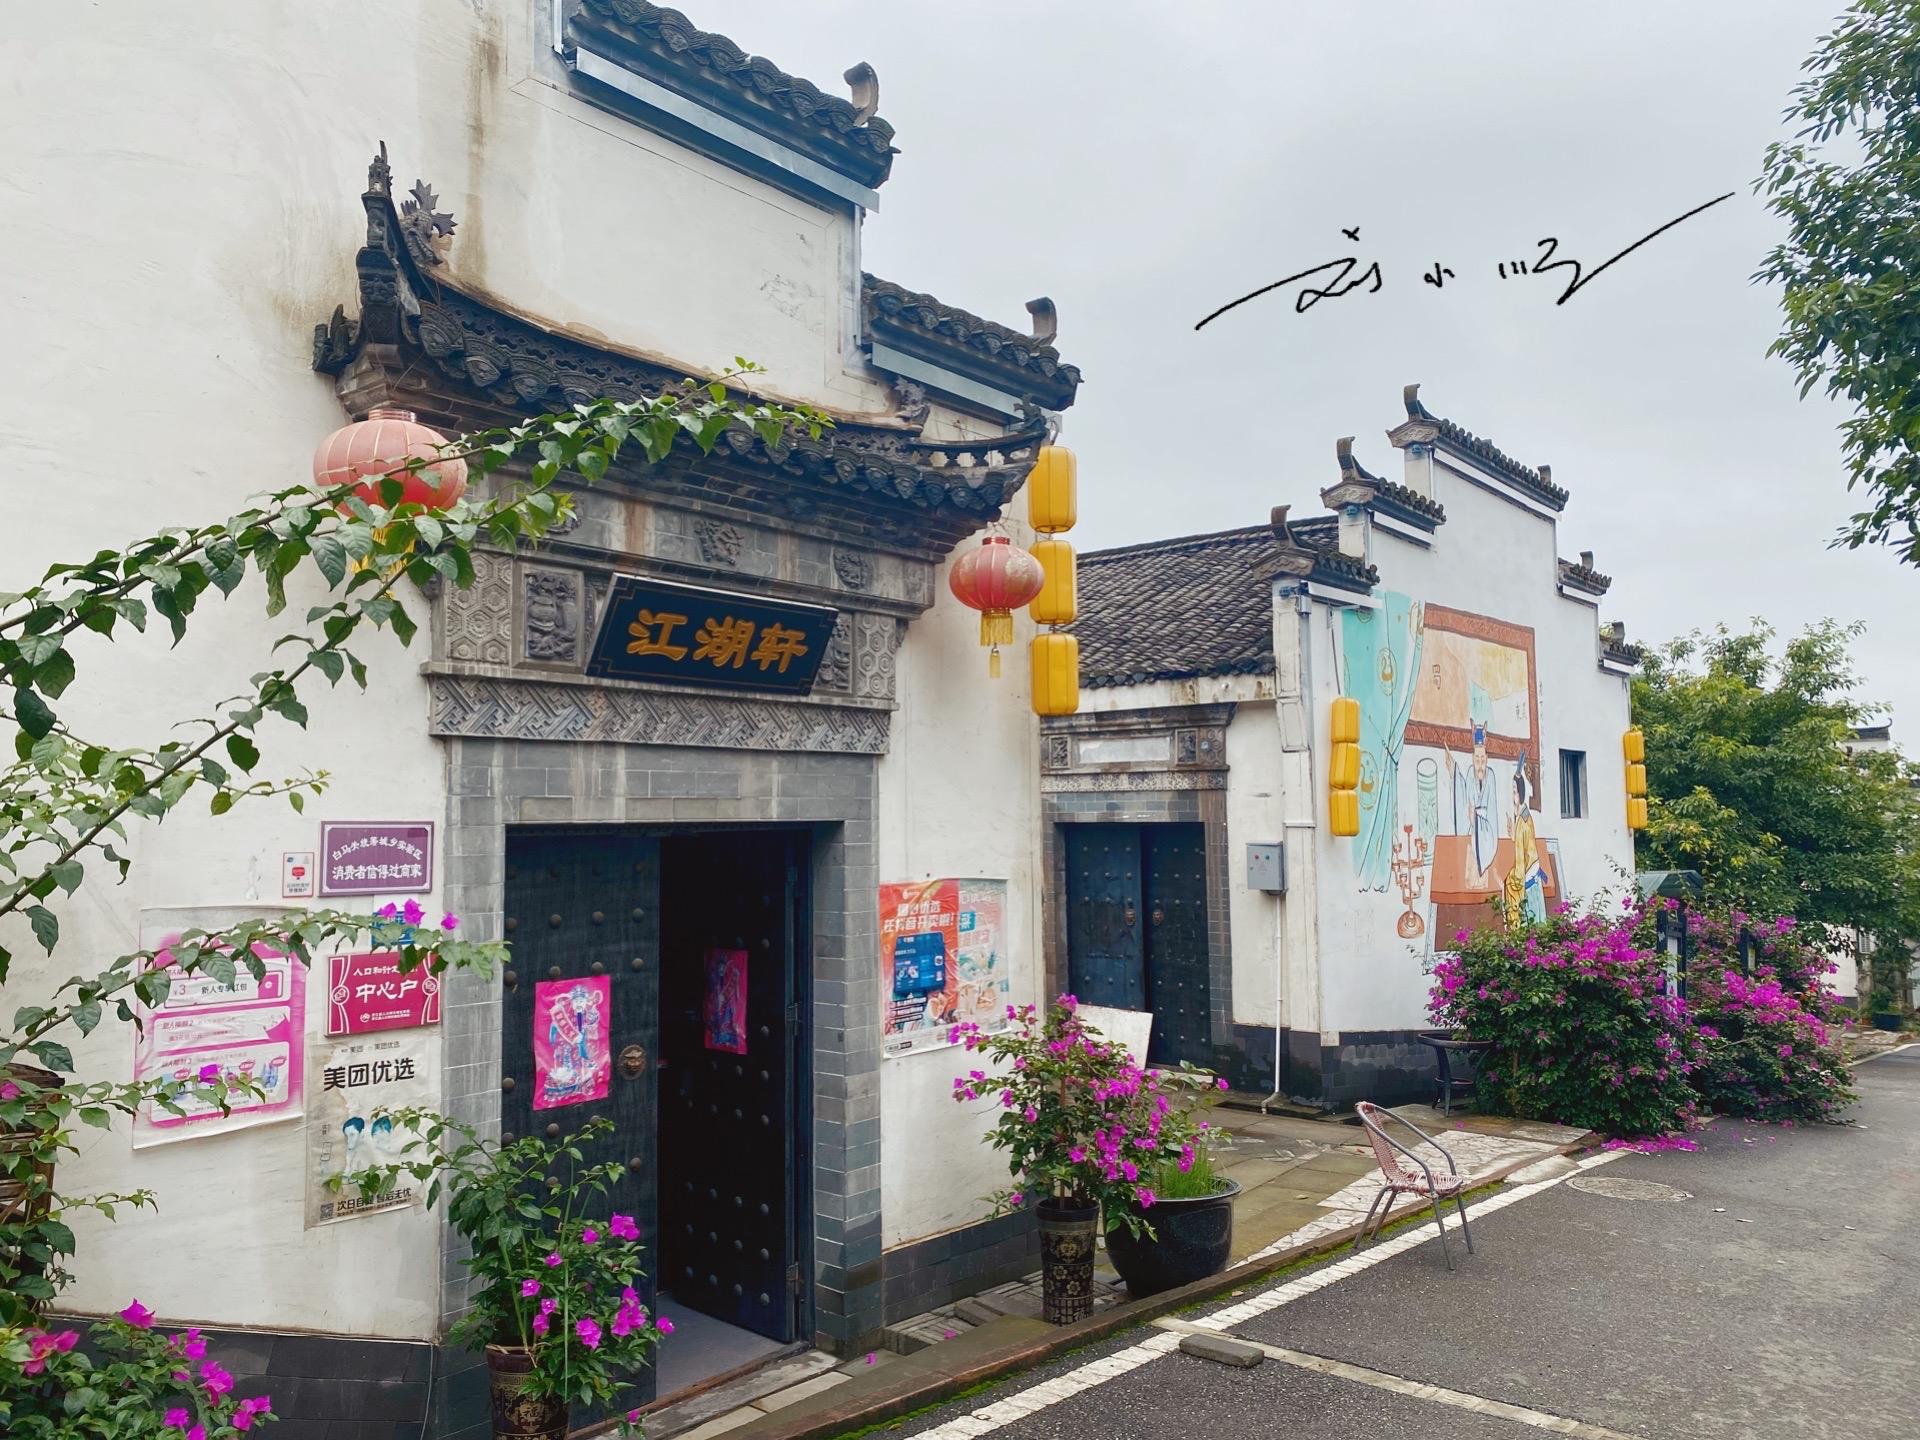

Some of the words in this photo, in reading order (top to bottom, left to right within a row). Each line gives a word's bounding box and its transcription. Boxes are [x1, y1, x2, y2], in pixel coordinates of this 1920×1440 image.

[626, 608, 808, 673] 江湖轩
[332, 864, 422, 881] 消费者信得过商家
[355, 980, 418, 1003] 中心户
[323, 1057, 414, 1091] 美团优选
